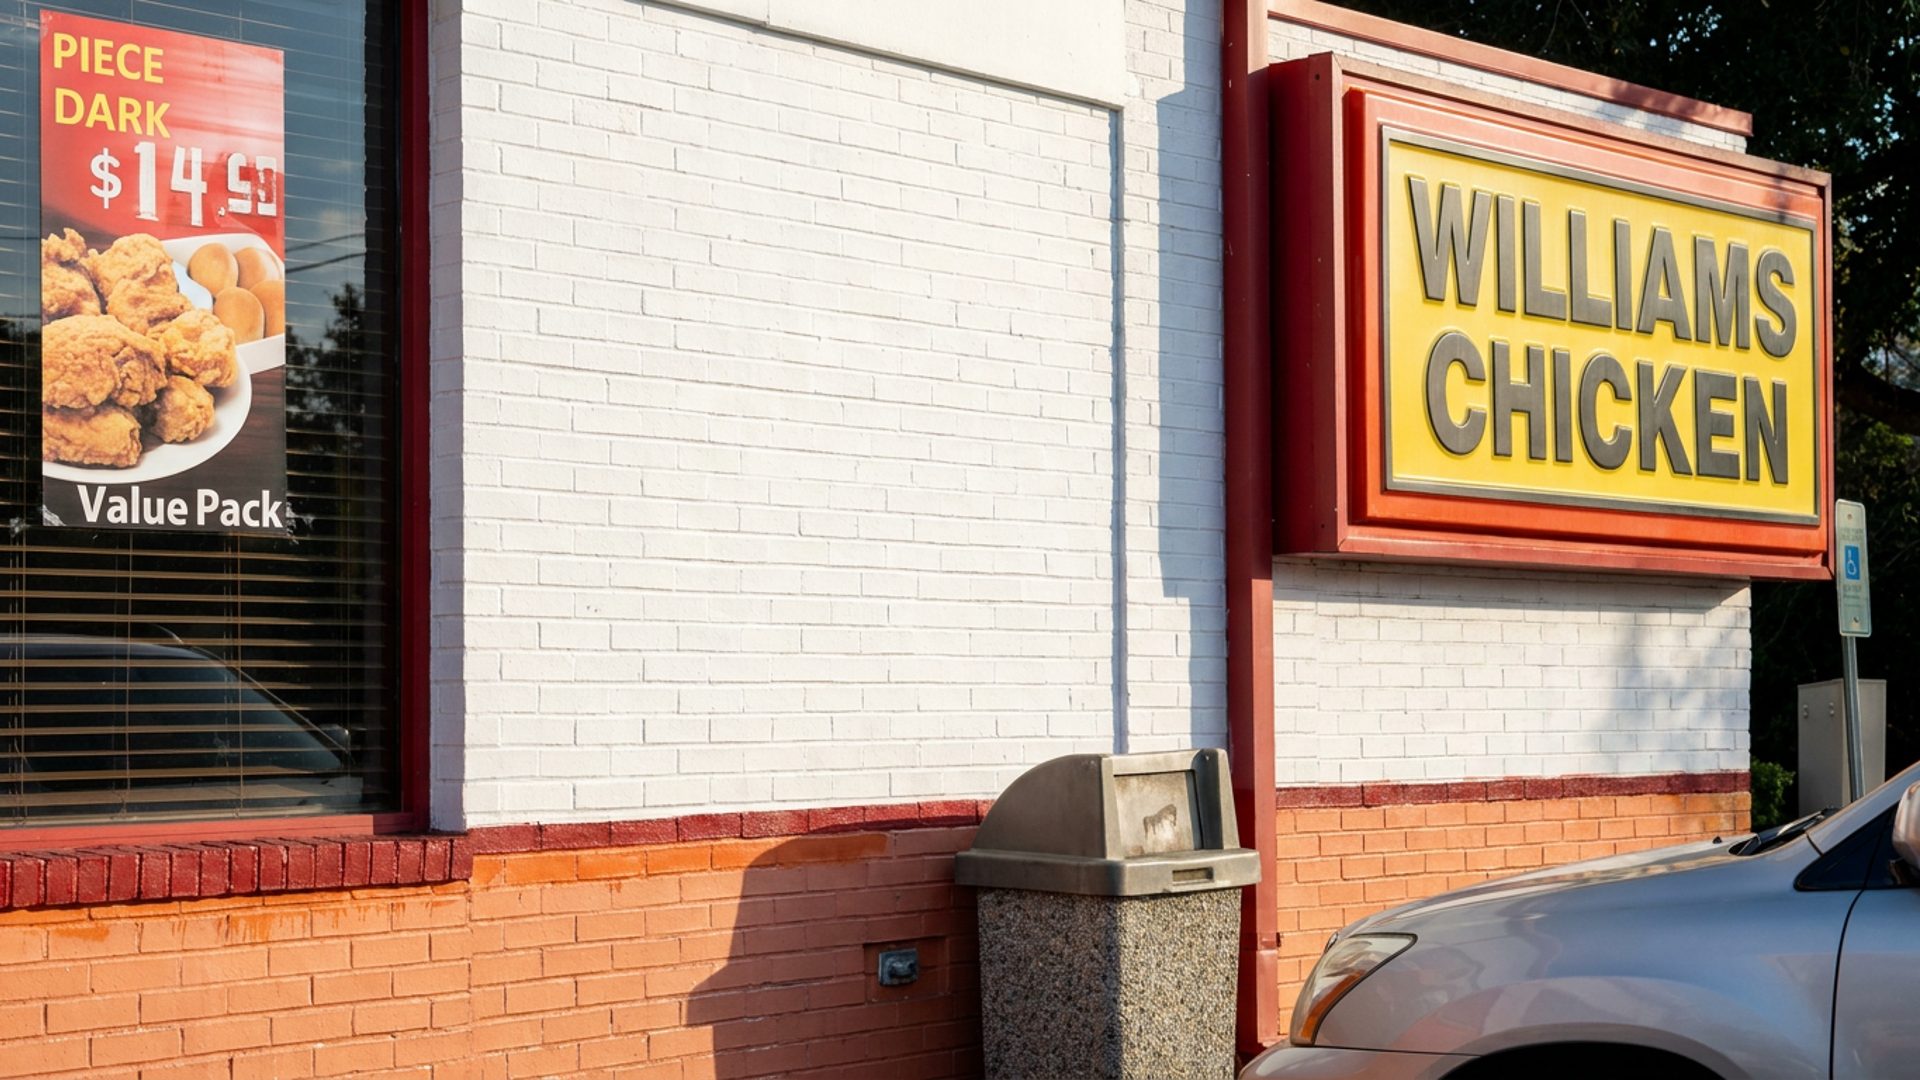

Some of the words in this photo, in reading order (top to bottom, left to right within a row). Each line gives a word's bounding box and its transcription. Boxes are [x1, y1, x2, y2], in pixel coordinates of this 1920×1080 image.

[53, 32, 164, 84] PIECE
[55, 87, 171, 138] DARK
[1407, 175, 1797, 358] WILLIAMS
[1425, 330, 1789, 485] CHICKEN
[76, 484, 188, 525] Value
[196, 488, 283, 529] Pack
